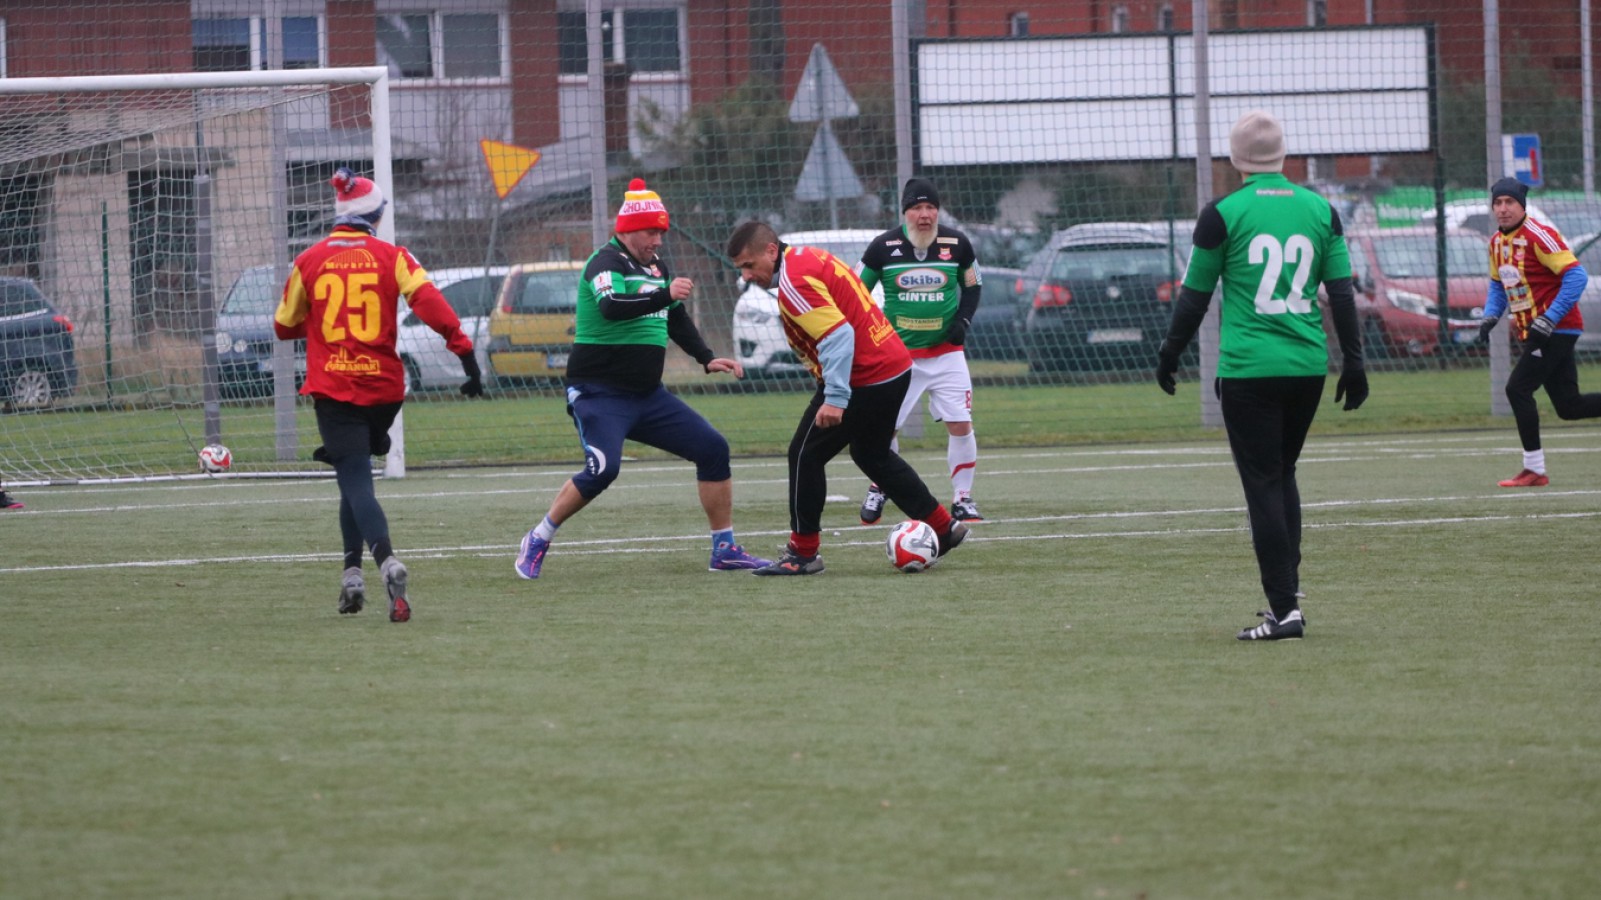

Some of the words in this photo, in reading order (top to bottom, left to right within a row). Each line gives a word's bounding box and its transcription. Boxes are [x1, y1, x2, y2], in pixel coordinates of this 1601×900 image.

[900, 275, 942, 286] Skiba
[1248, 233, 1314, 315] 22
[314, 272, 381, 343] 25
[897, 291, 945, 302] GINTER
